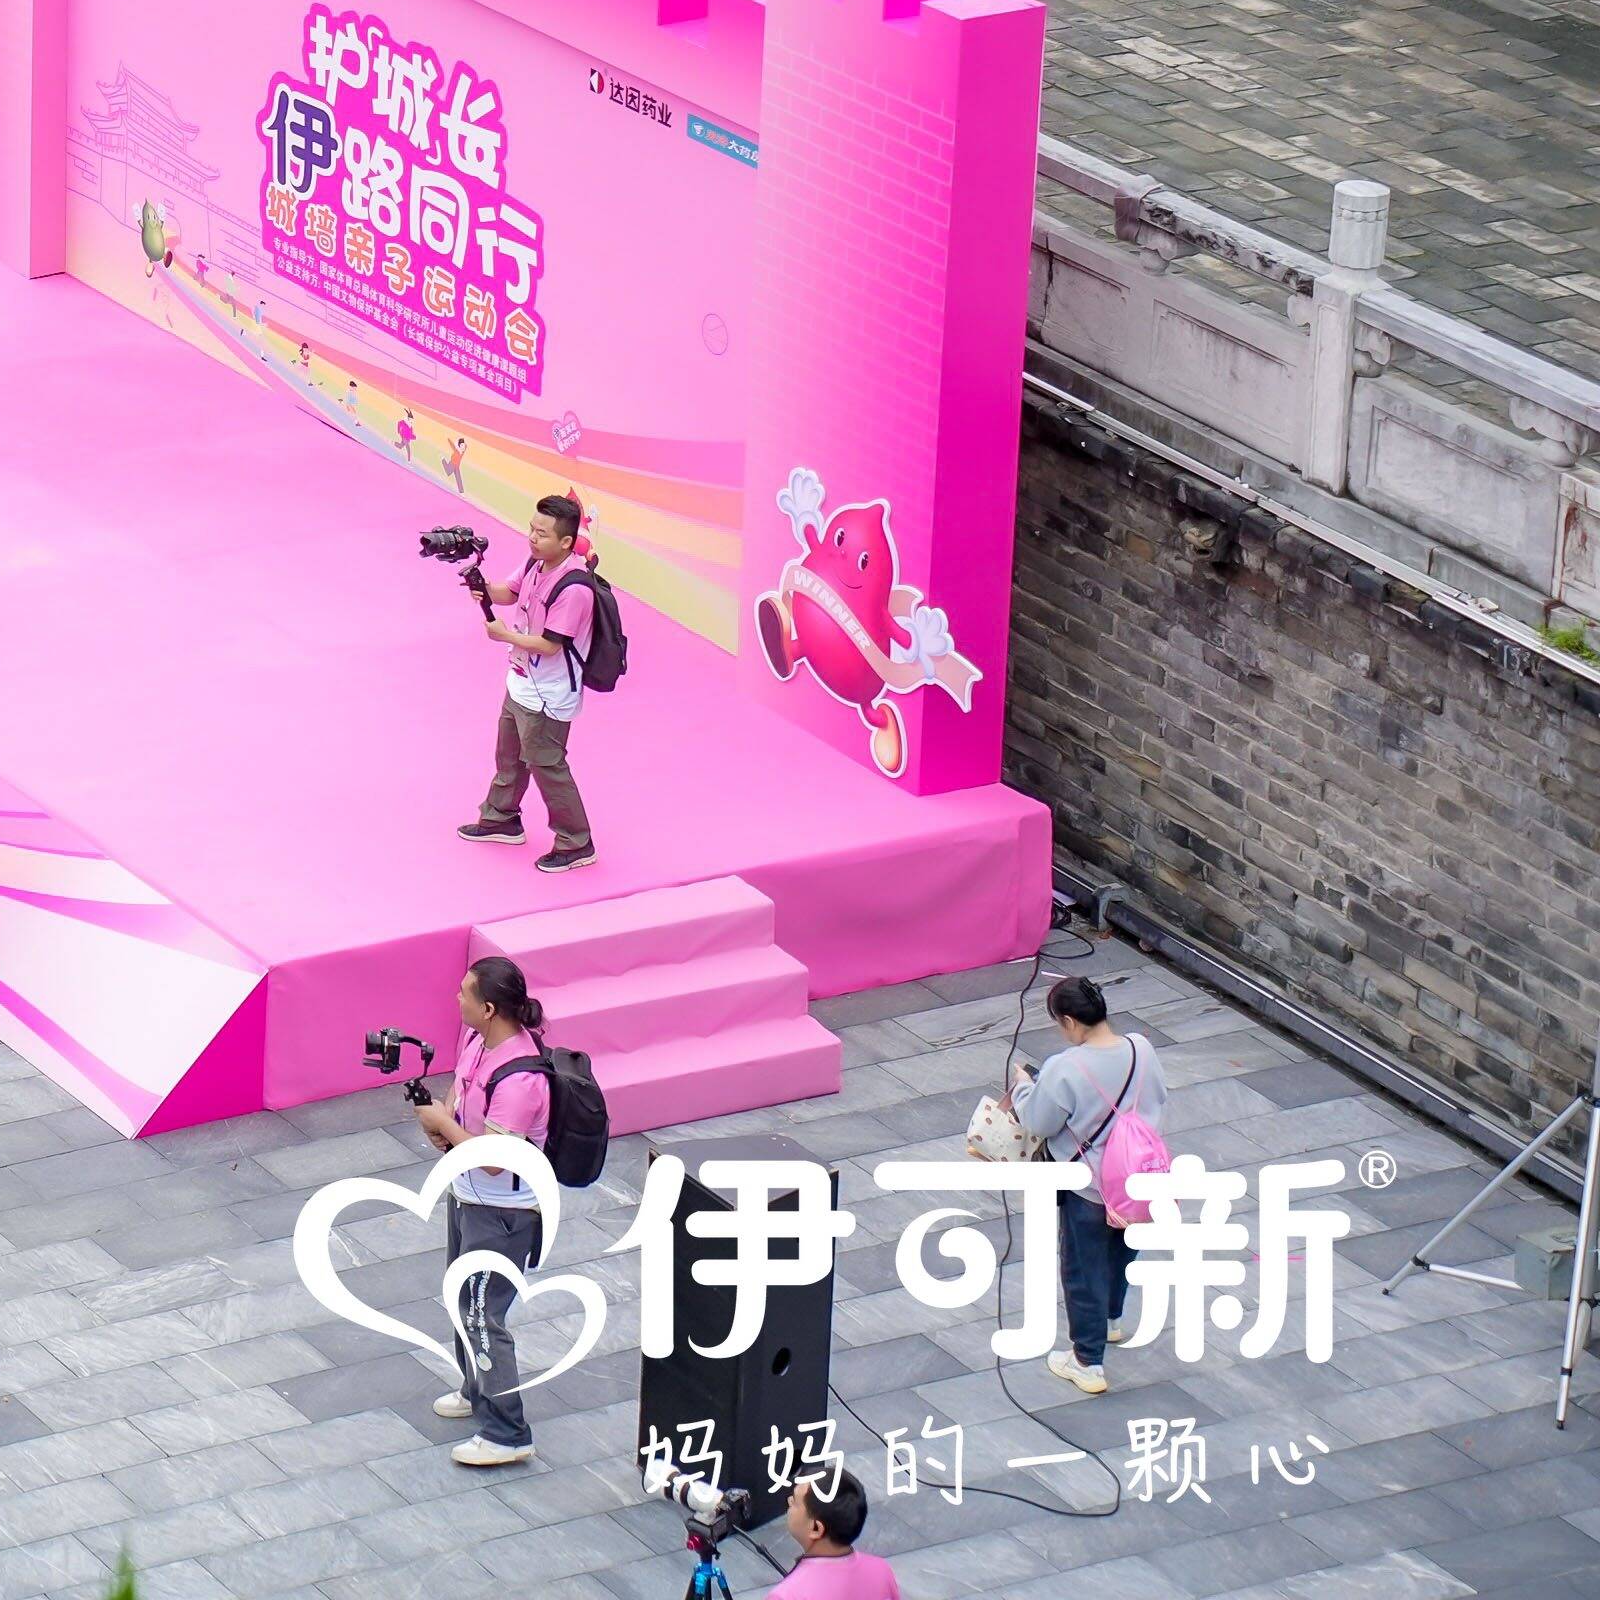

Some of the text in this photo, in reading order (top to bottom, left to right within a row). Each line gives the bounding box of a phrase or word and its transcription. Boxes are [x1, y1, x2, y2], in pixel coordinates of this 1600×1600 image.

[307, 13, 502, 190] 护城长
[609, 77, 673, 129] 达因药业
[261, 83, 539, 306] 伊路同行
[265, 183, 540, 366] 城墙亲子运动会
[791, 569, 872, 650] WINNER
